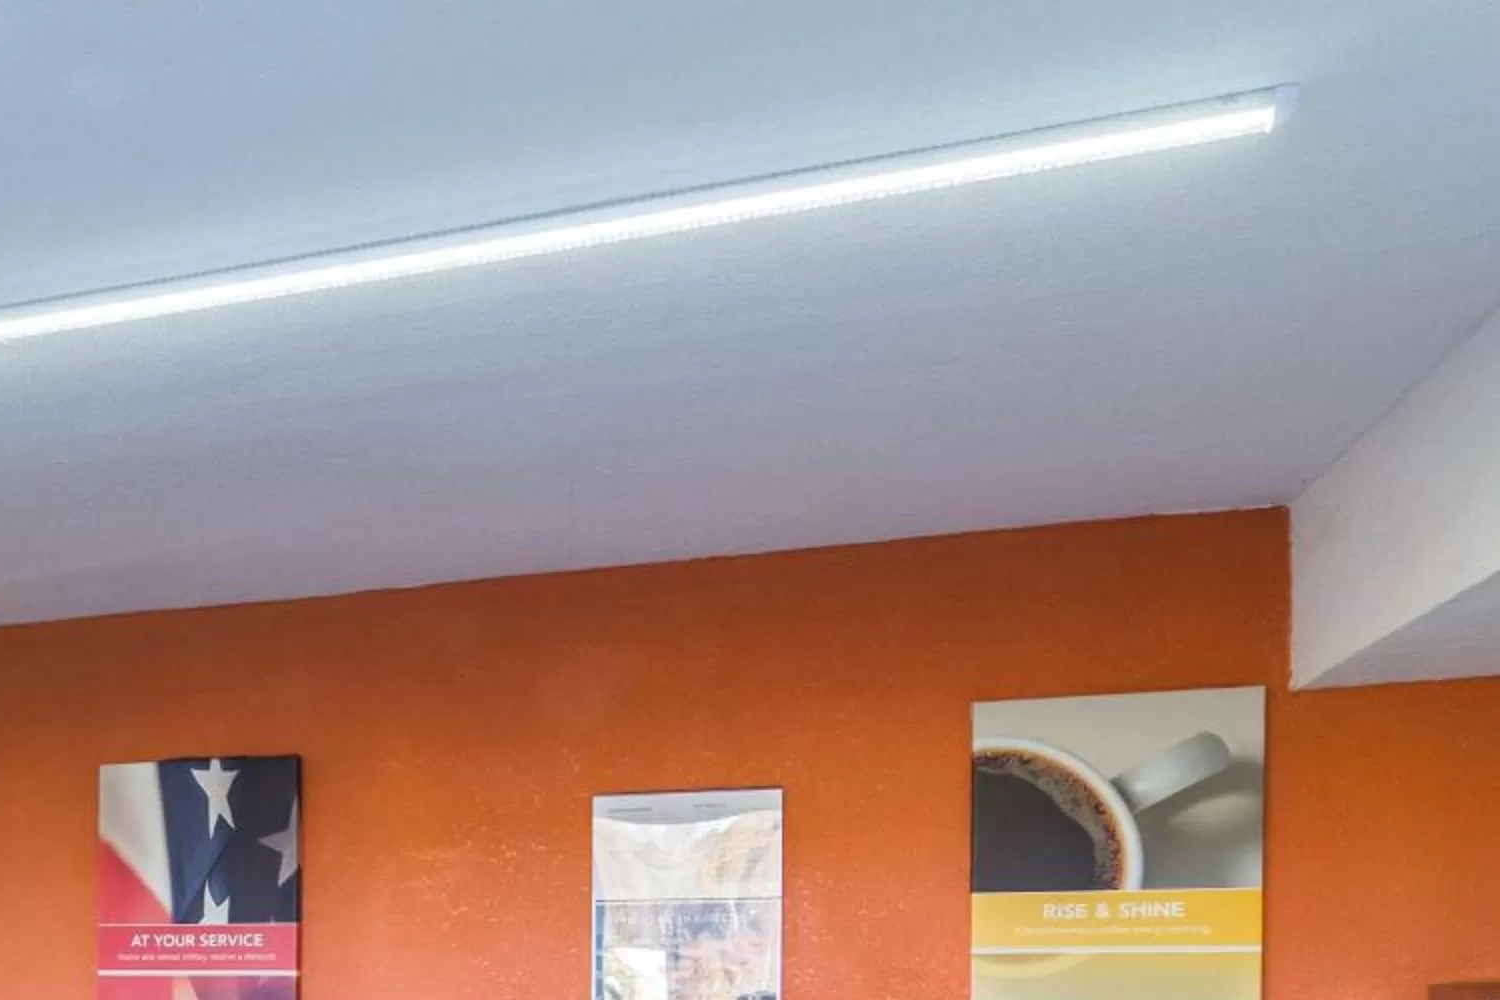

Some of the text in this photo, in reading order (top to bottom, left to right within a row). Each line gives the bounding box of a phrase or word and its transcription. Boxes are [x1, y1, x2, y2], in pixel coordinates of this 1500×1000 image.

[1043, 901, 1186, 919] RISE & SHINE
[131, 933, 264, 947] AT YOUR SERVICE
